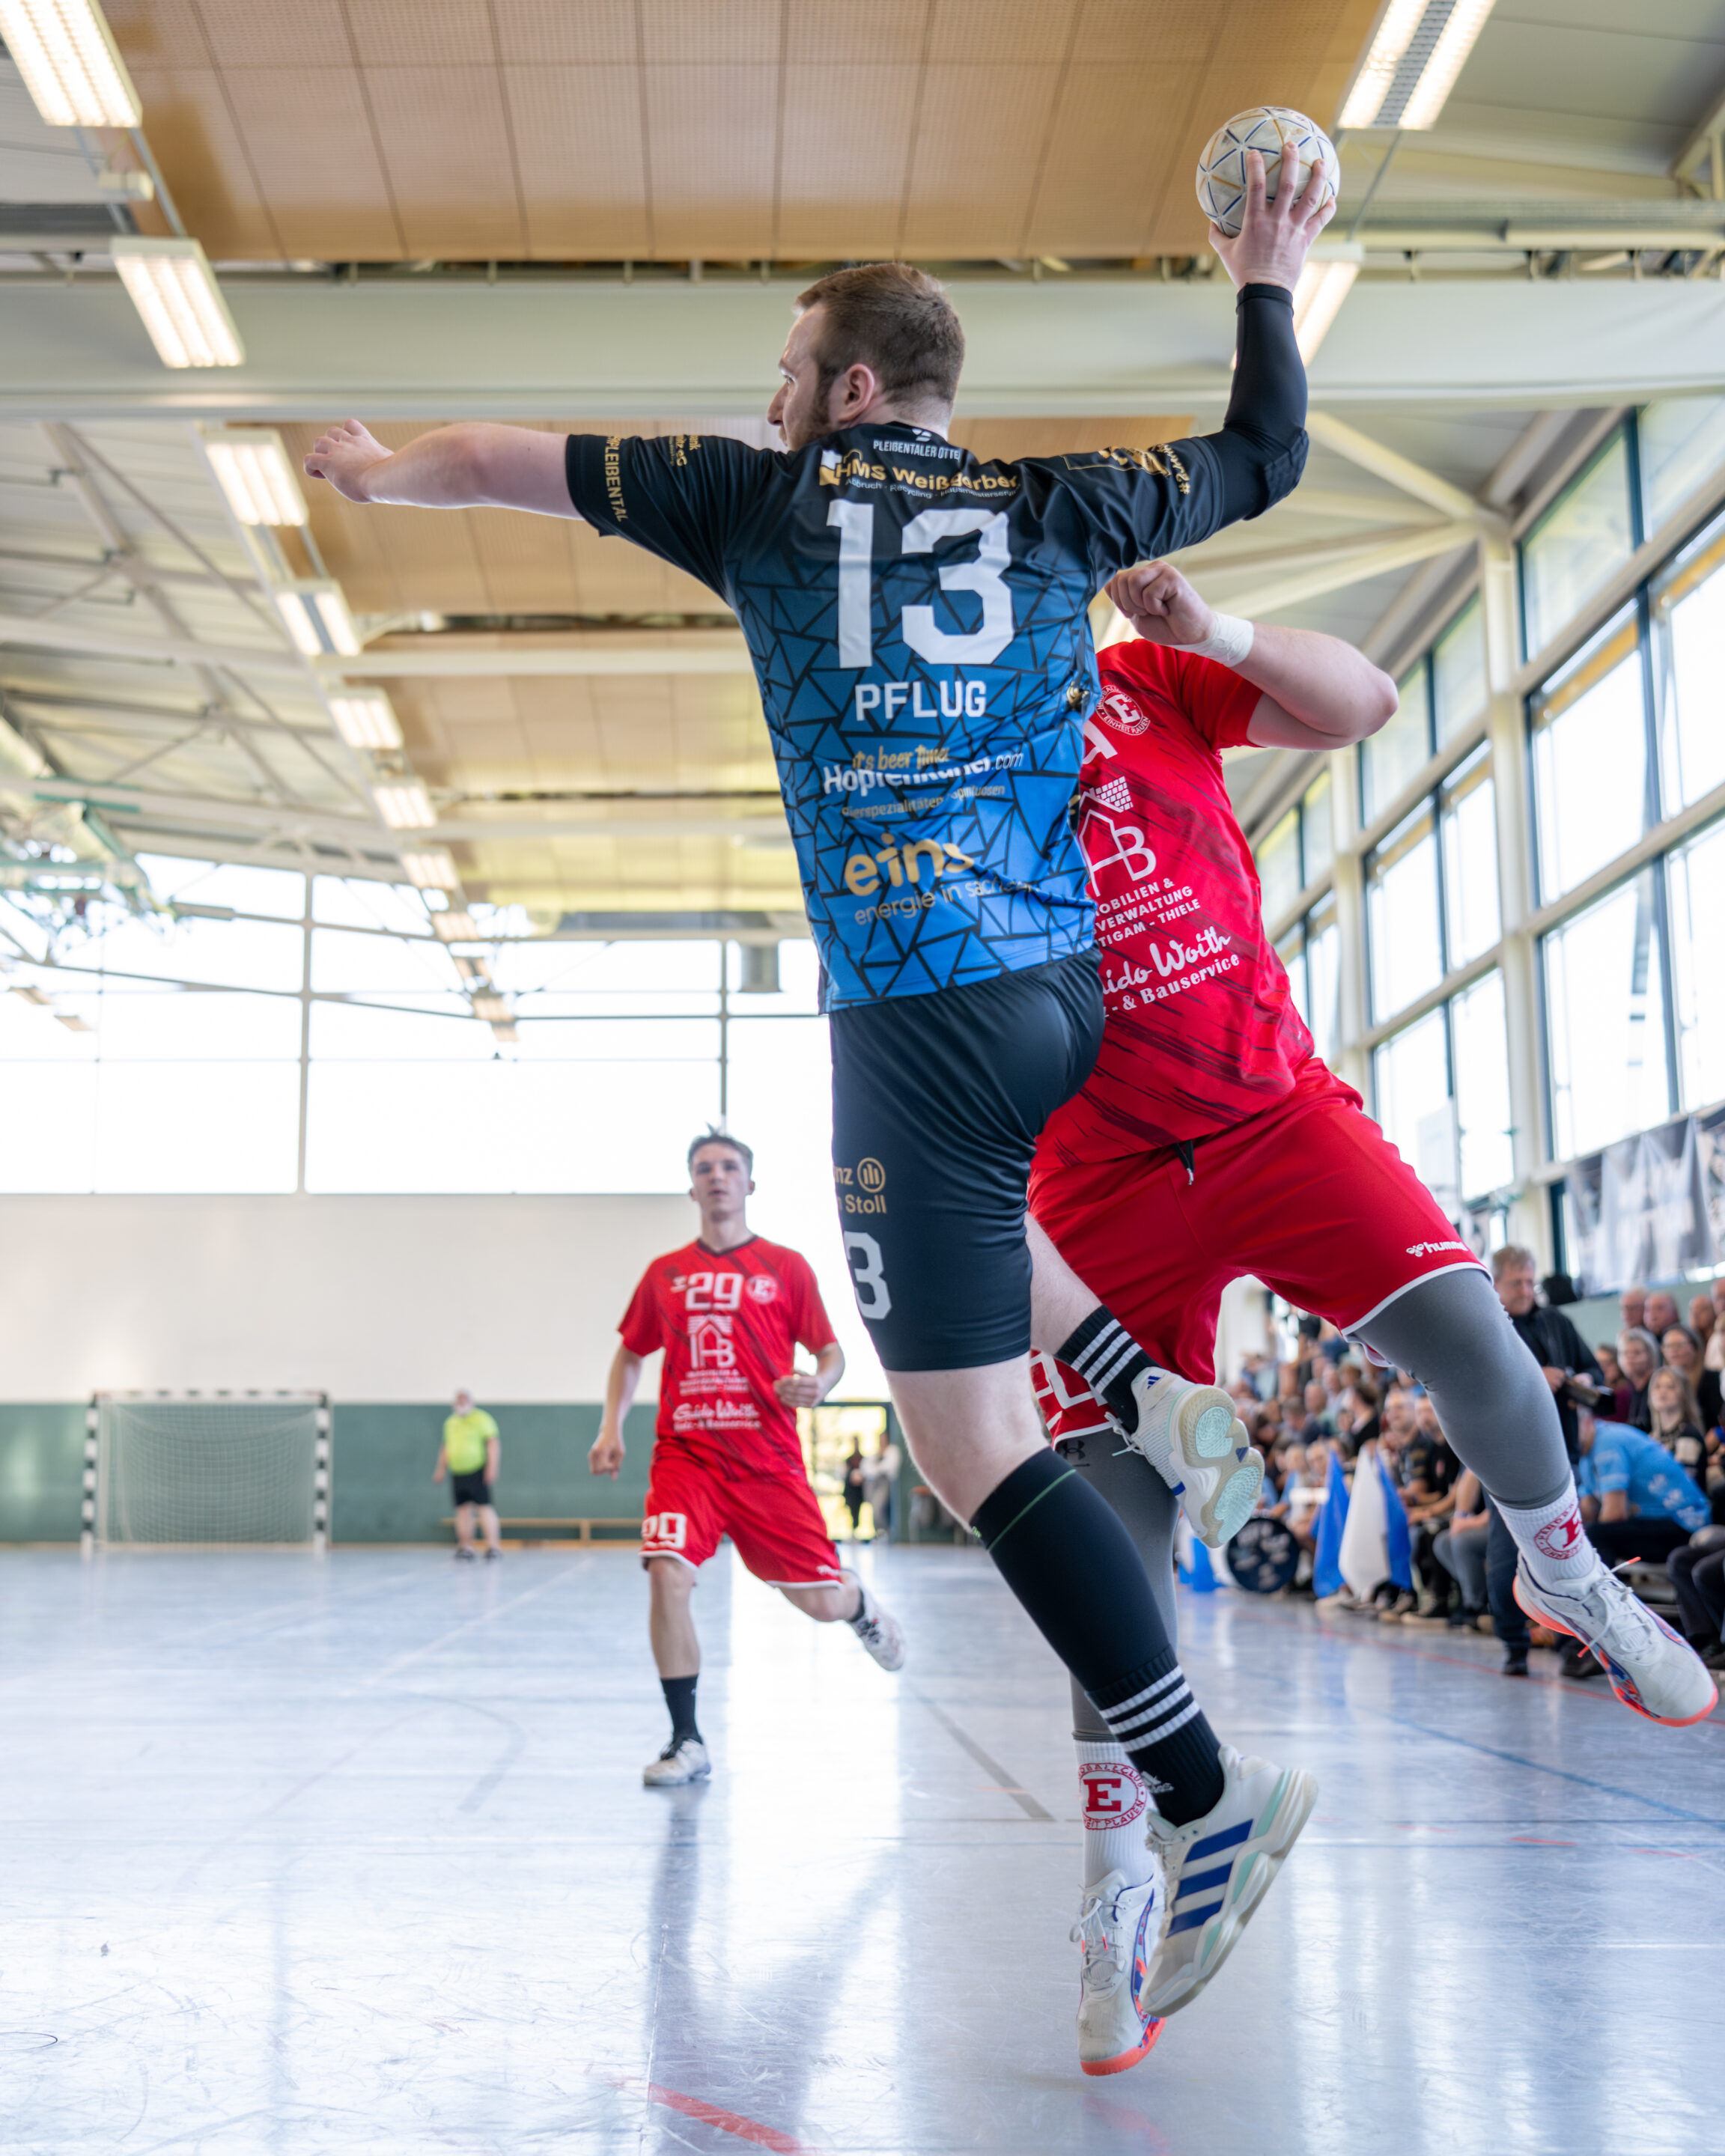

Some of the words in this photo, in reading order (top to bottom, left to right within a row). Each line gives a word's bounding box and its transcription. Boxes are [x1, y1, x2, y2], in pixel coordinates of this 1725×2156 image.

[827, 499, 1014, 669] 13
[855, 680, 987, 721] PFLUG
[877, 745, 913, 770] beer
[1163, 877, 1175, 889] &
[855, 890, 936, 925] energie
[940, 883, 962, 903] in
[1094, 886, 1193, 935] VERWALTUNG
[1158, 898, 1201, 924] THIELE
[1122, 995, 1137, 1011] &
[1140, 954, 1240, 1005] Bauservice
[845, 1194, 887, 1214] Stoll
[686, 1272, 744, 1310] 29
[1083, 1778, 1122, 1812] E
